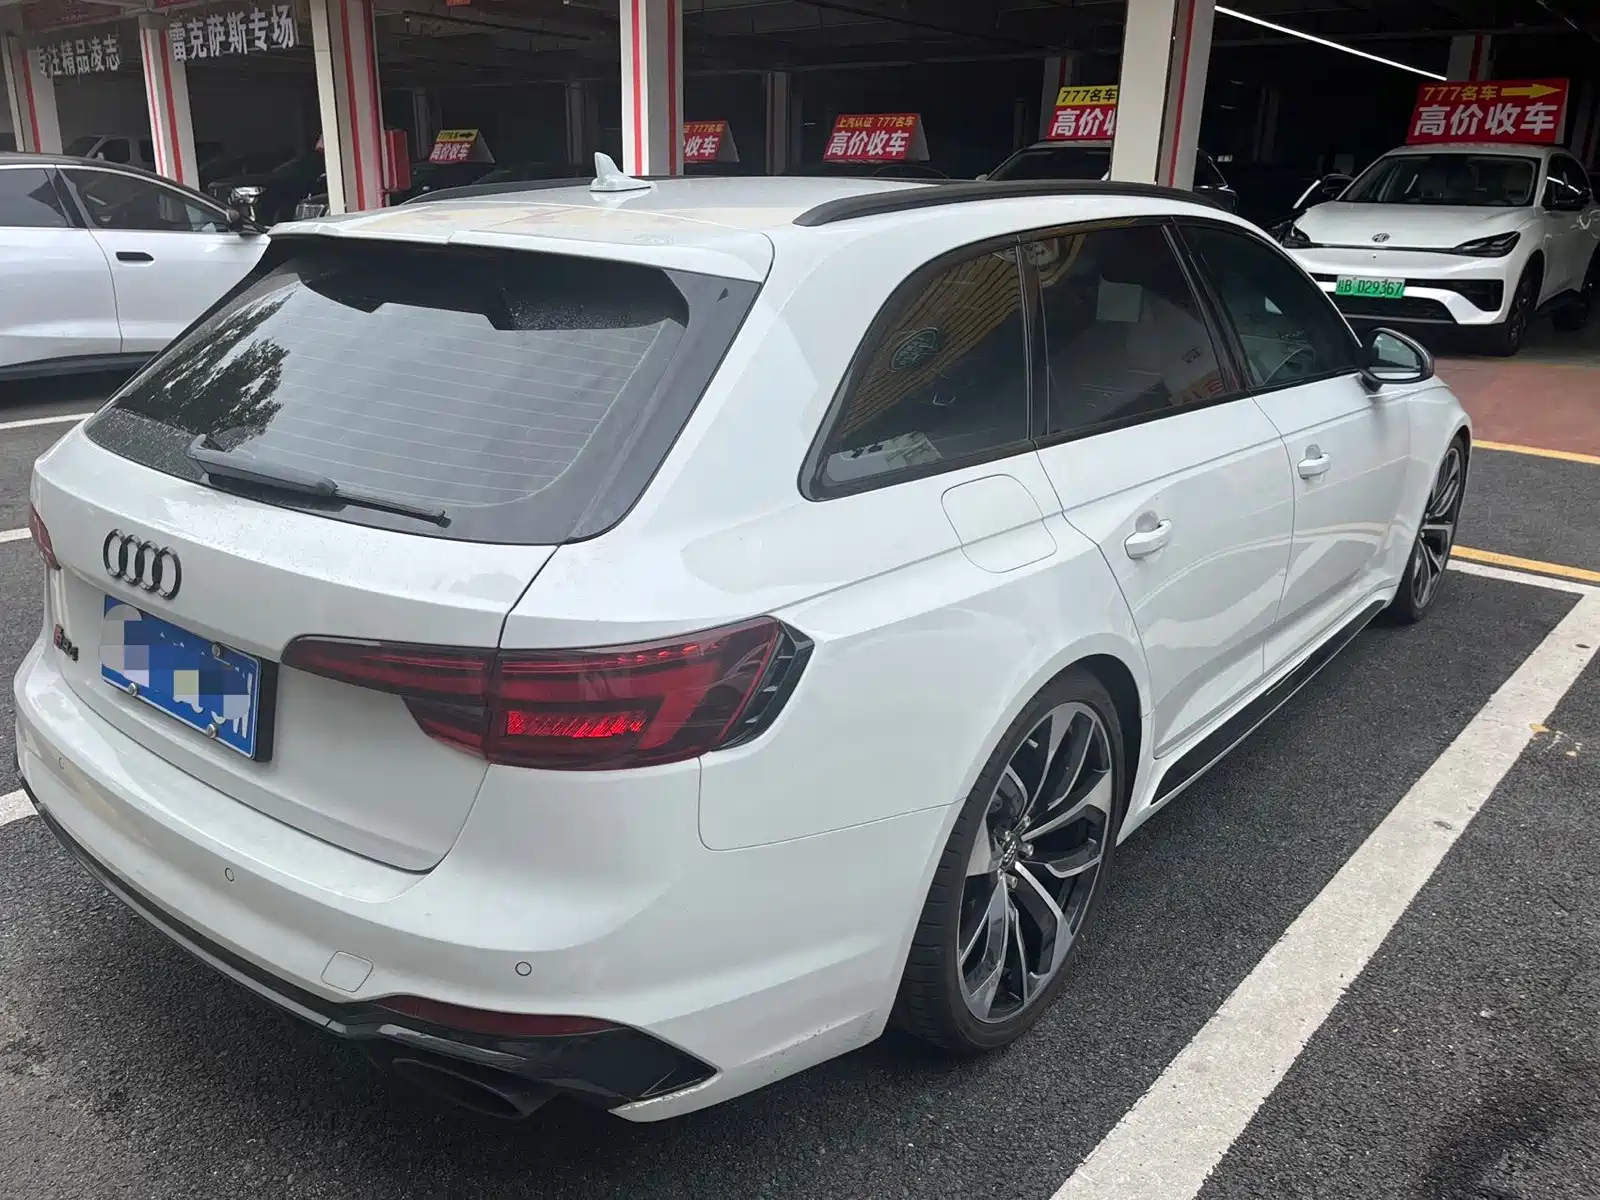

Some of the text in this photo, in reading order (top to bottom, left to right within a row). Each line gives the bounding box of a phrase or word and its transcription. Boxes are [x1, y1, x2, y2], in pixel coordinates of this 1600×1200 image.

[169, 4, 295, 61] 雷克萨斯专场
[1062, 88, 1118, 102] 777名车
[1424, 85, 1498, 101] 777名车
[1413, 102, 1558, 136] 高价收车
[683, 135, 719, 157] 收车
[827, 130, 909, 156] 高价收车
